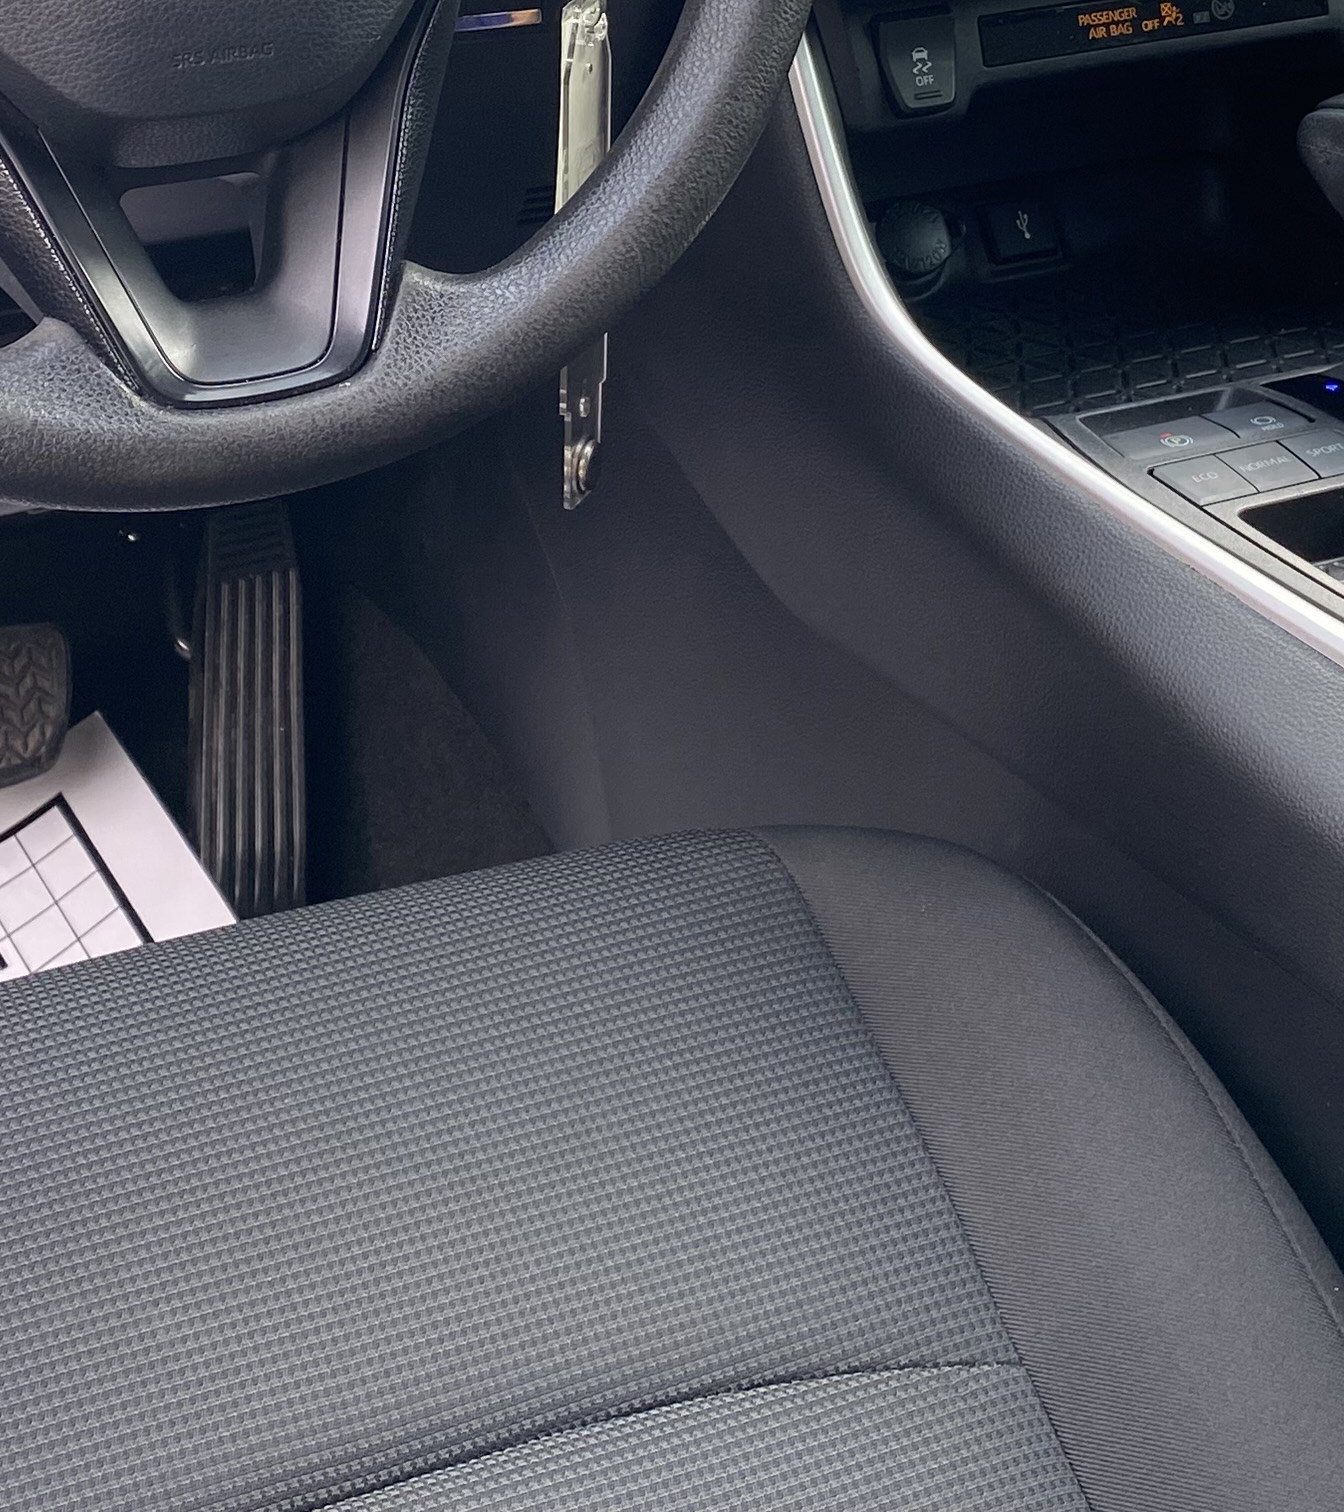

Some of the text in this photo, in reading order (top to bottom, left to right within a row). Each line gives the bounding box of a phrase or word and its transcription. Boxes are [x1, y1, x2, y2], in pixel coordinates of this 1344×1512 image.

[1077, 7, 1138, 27] PASSENGER
[1089, 25, 1107, 40] AIR
[1109, 22, 1133, 36] BAG
[1141, 19, 1160, 32] OFF
[915, 75, 935, 87] OFF
[1306, 442, 1344, 457] SPORT
[1238, 455, 1291, 473] NORMAL
[1191, 471, 1218, 483] ECO
